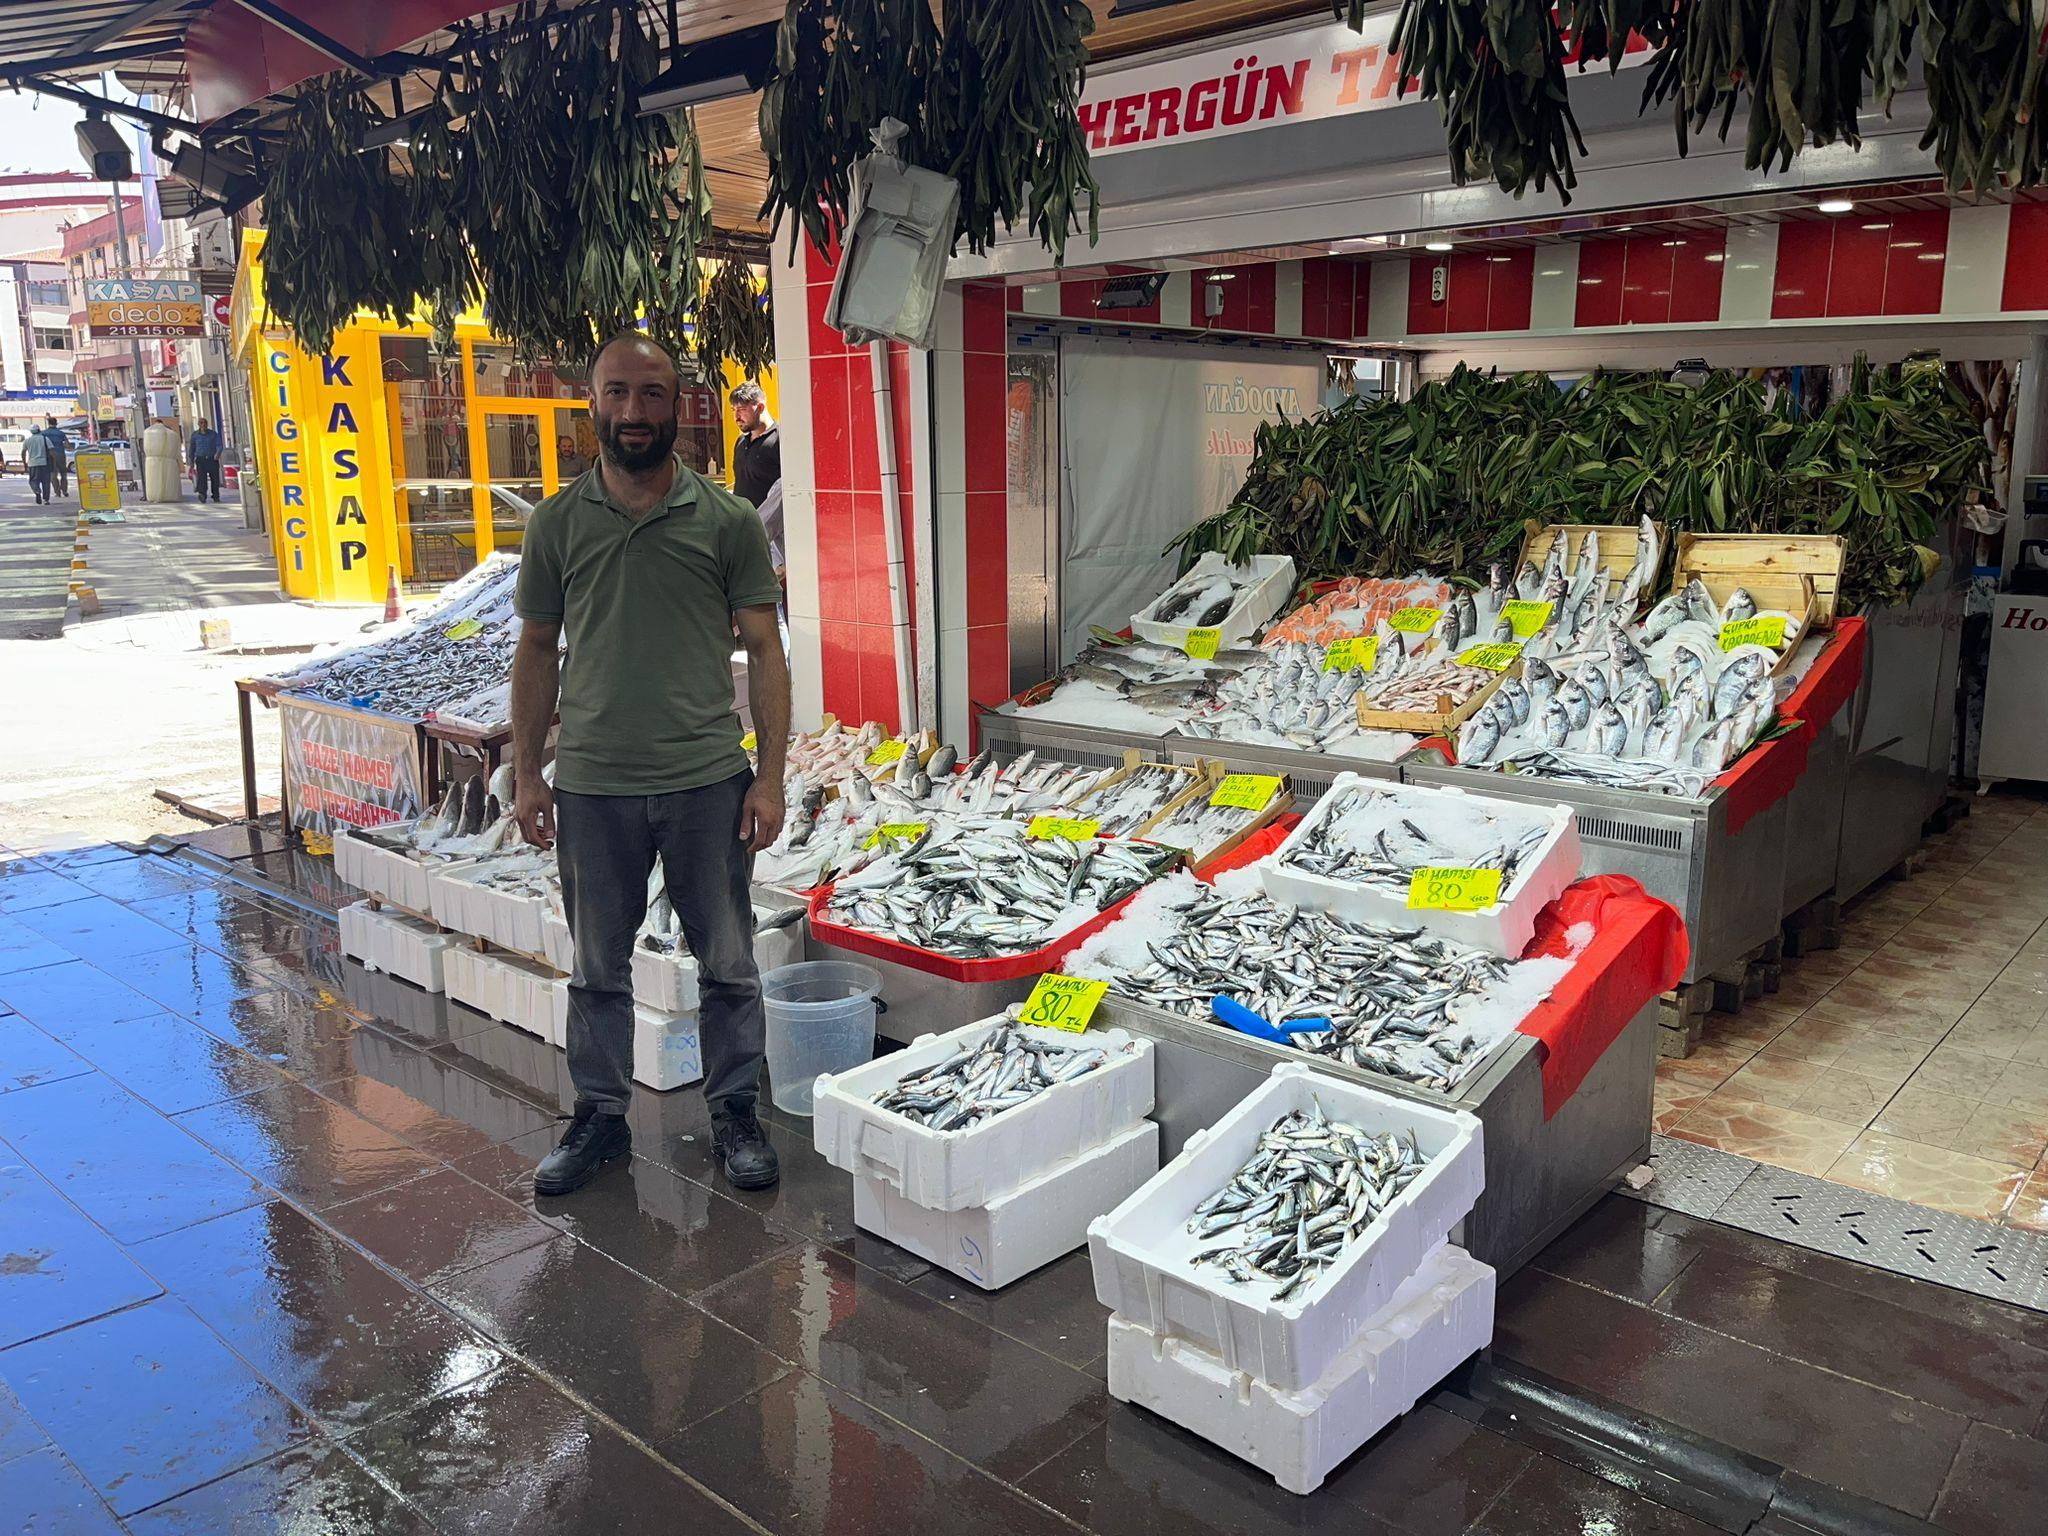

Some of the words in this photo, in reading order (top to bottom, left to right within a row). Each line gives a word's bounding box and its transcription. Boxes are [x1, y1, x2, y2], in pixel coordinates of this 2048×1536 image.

[1078, 55, 1311, 150] HERGÜN
[87, 281, 196, 301] KASAP
[108, 304, 182, 323] dedo
[109, 326, 138, 335] 218
[144, 326, 162, 335] 15
[166, 326, 186, 335] 06
[321, 354, 368, 571] KASAP
[302, 739, 340, 776] TAZE
[341, 749, 393, 792] HAMSİ
[302, 782, 321, 813] BU
[1427, 881, 1463, 903] 80
[1030, 991, 1073, 1023] 80
